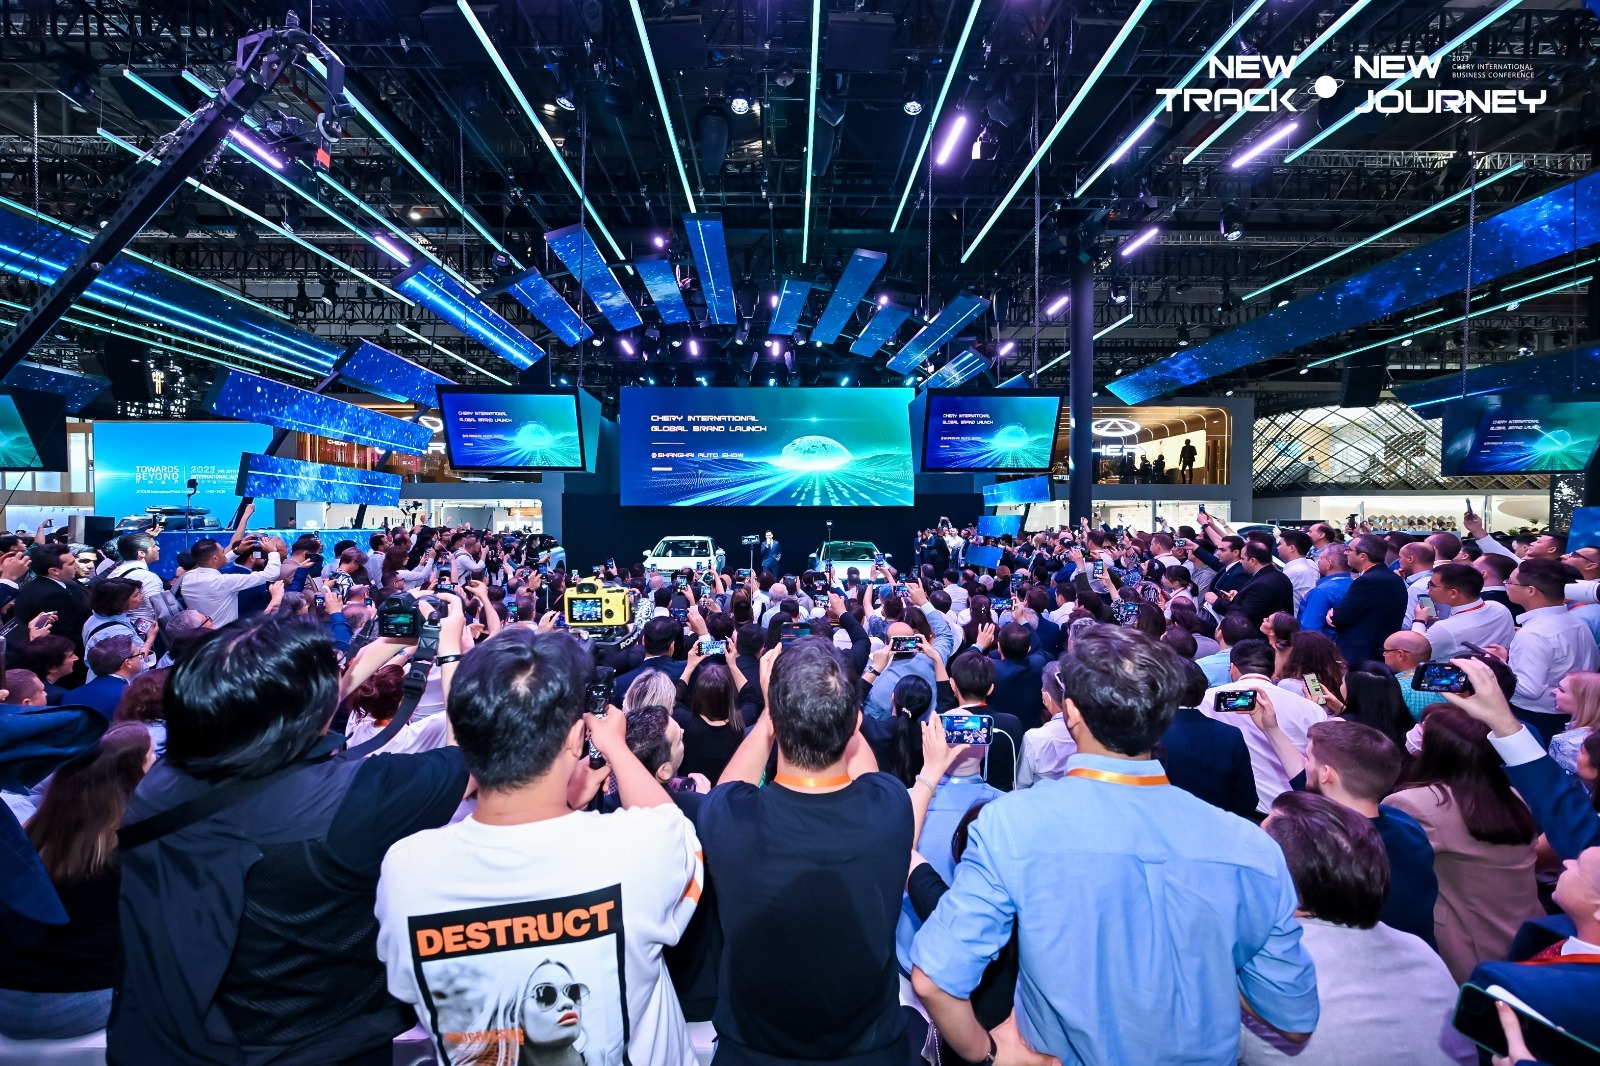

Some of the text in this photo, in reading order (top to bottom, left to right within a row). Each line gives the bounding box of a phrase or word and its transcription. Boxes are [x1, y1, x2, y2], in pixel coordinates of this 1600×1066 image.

[650, 414, 759, 422] CHERY INTERNATIONAL
[135, 465, 179, 473] TOWARDS
[190, 465, 215, 474] 2023
[416, 900, 615, 957] DESTRUCT
